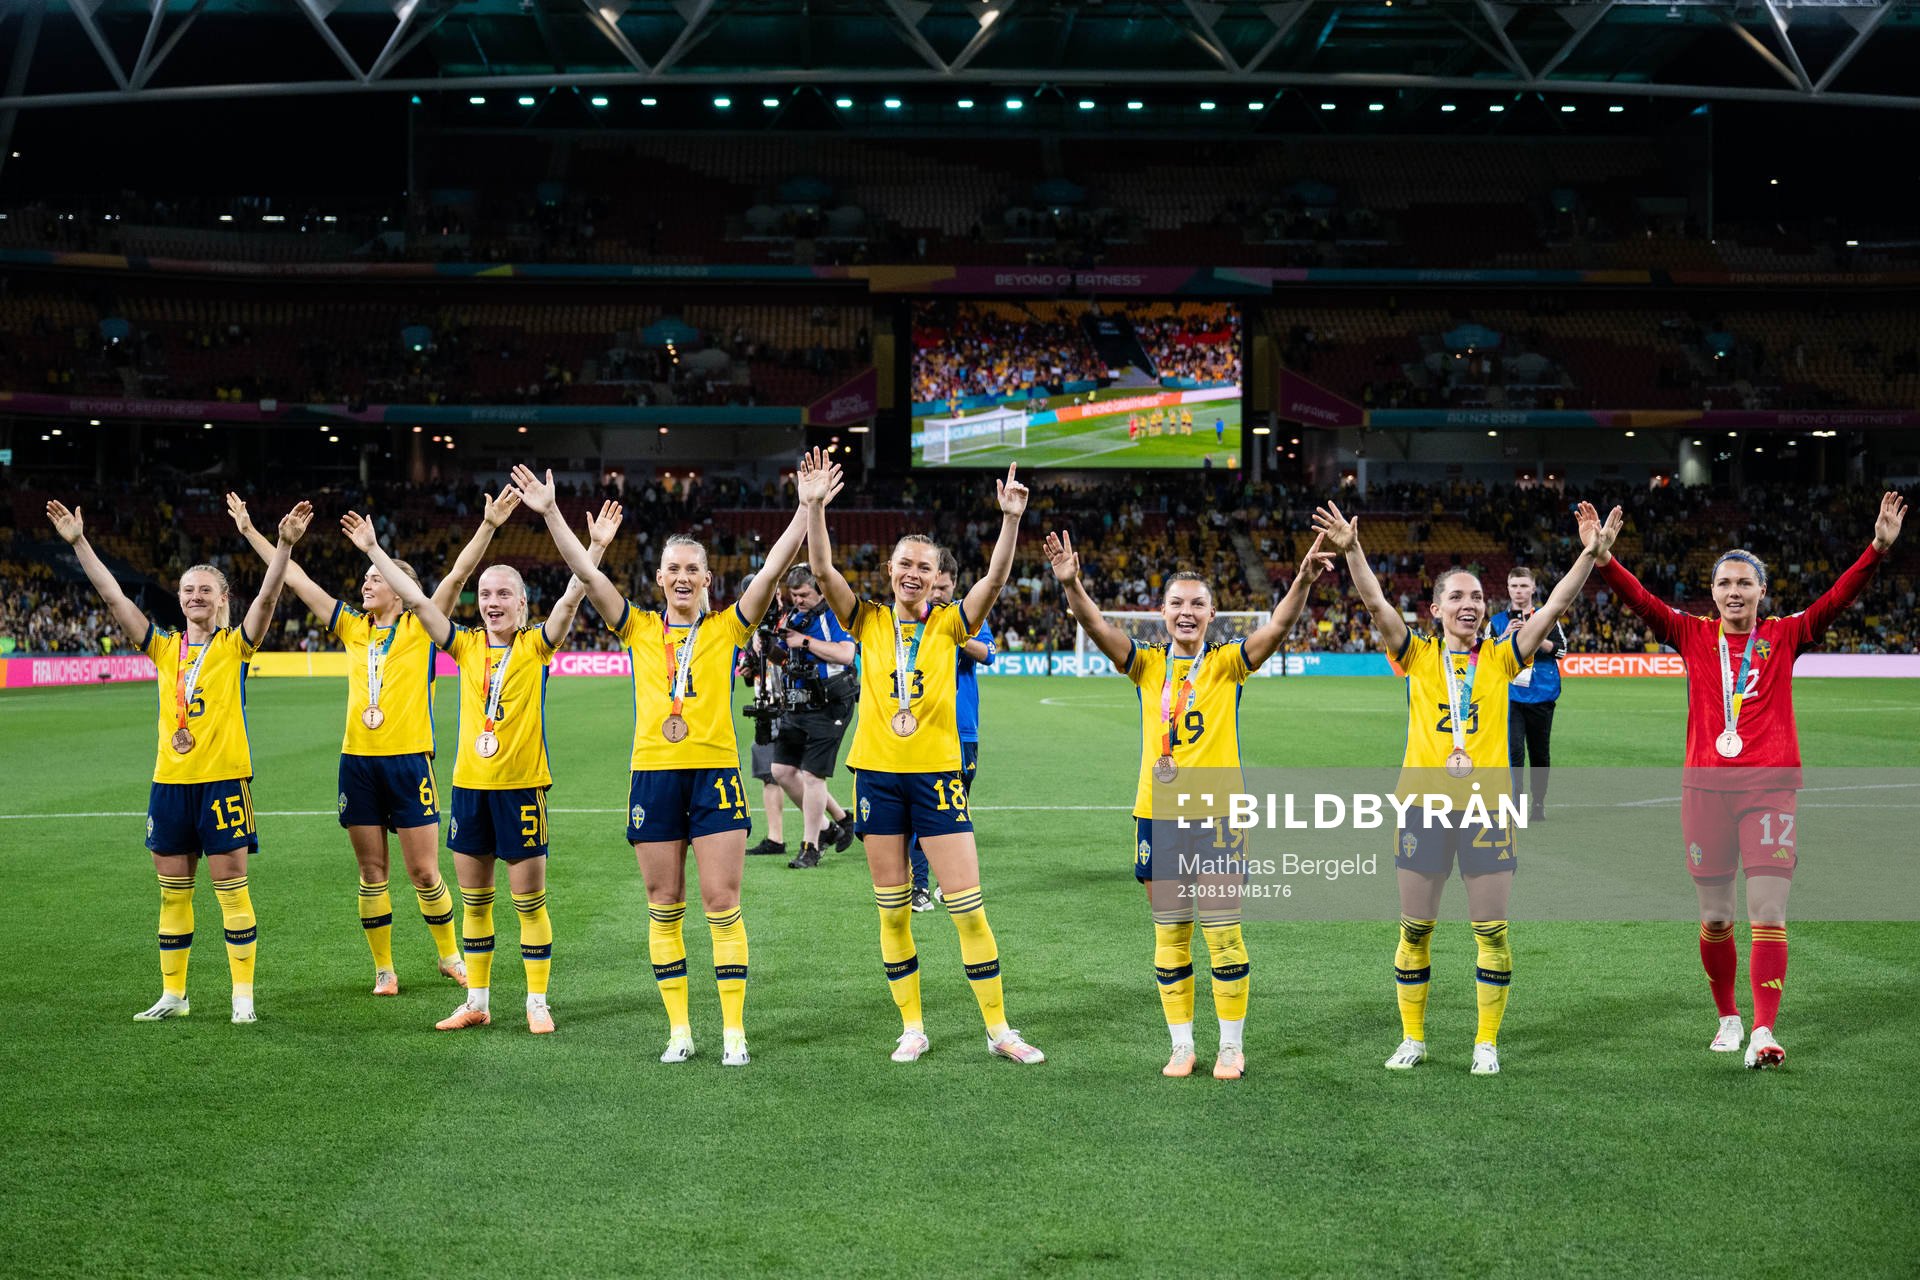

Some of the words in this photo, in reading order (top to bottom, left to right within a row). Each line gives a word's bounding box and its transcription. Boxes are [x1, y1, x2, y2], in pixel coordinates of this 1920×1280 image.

[995, 274, 1053, 286] BEYOND
[70, 400, 123, 413] BEYOND
[1777, 414, 1827, 424] BEYOND
[33, 660, 51, 684] FIFA
[1563, 656, 1688, 675] GREATNES
[419, 777, 434, 806] 6
[714, 775, 745, 810] 11
[933, 779, 966, 810] 18
[211, 794, 246, 831] 15
[520, 805, 538, 836] 5
[1759, 813, 1794, 847] 12
